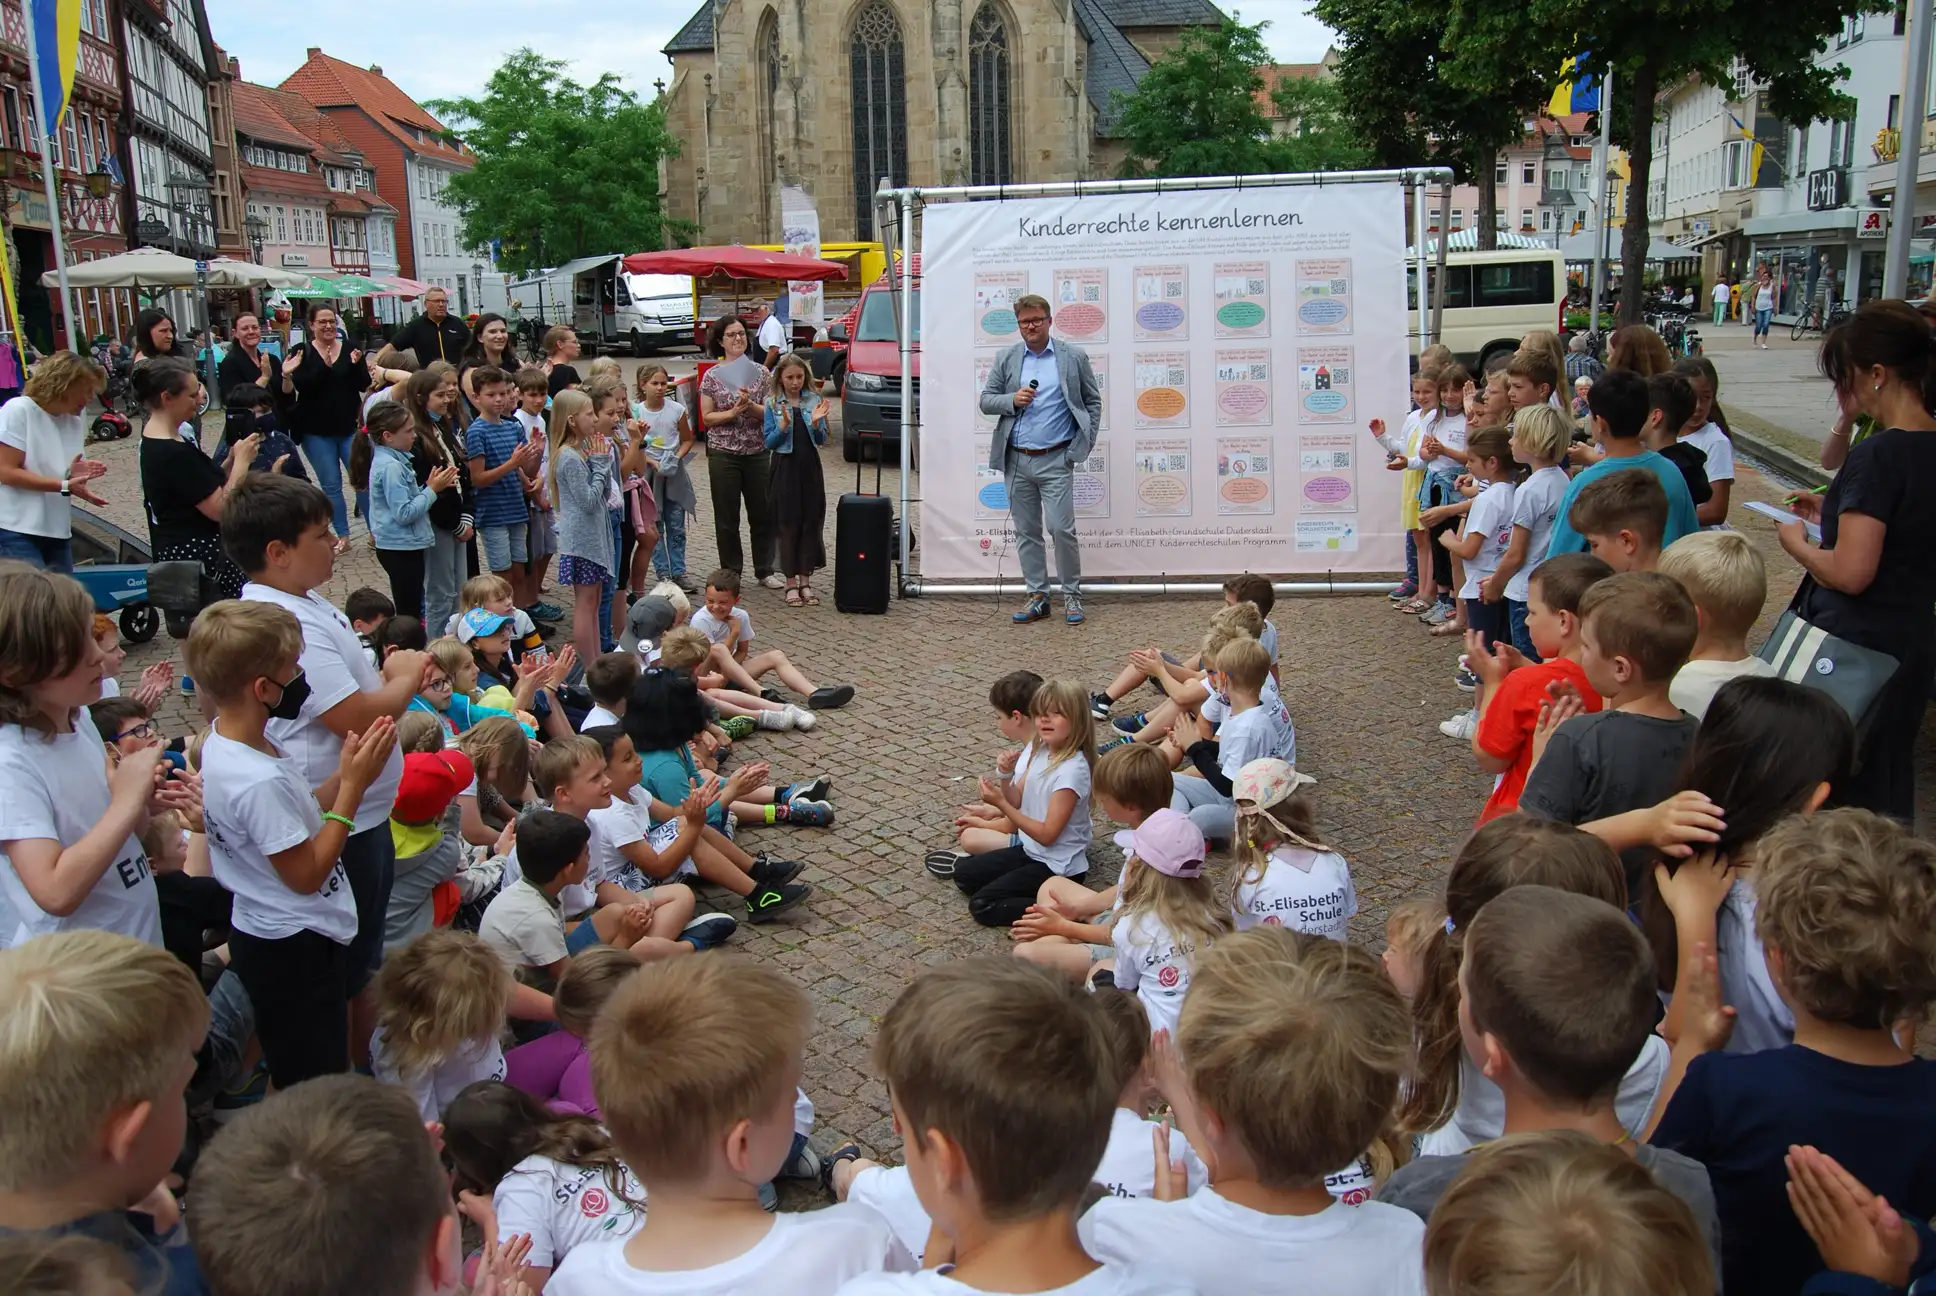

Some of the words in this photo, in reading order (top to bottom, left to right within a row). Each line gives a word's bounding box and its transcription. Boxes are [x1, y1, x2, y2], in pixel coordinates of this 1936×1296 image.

[1019, 212, 1150, 237] Kinderrechte
[1157, 207, 1304, 231] kennenlernen
[1226, 526, 1273, 535] Duderstadt
[1088, 541, 1102, 549] mit
[1105, 540, 1122, 548] dem
[1124, 539, 1157, 548] UNICEF
[1159, 538, 1241, 547] Kinderrechteschulen
[1243, 537, 1287, 548] Programm
[1254, 892, 1342, 912] St.-Elisabeth-
[1299, 907, 1342, 922] Schule
